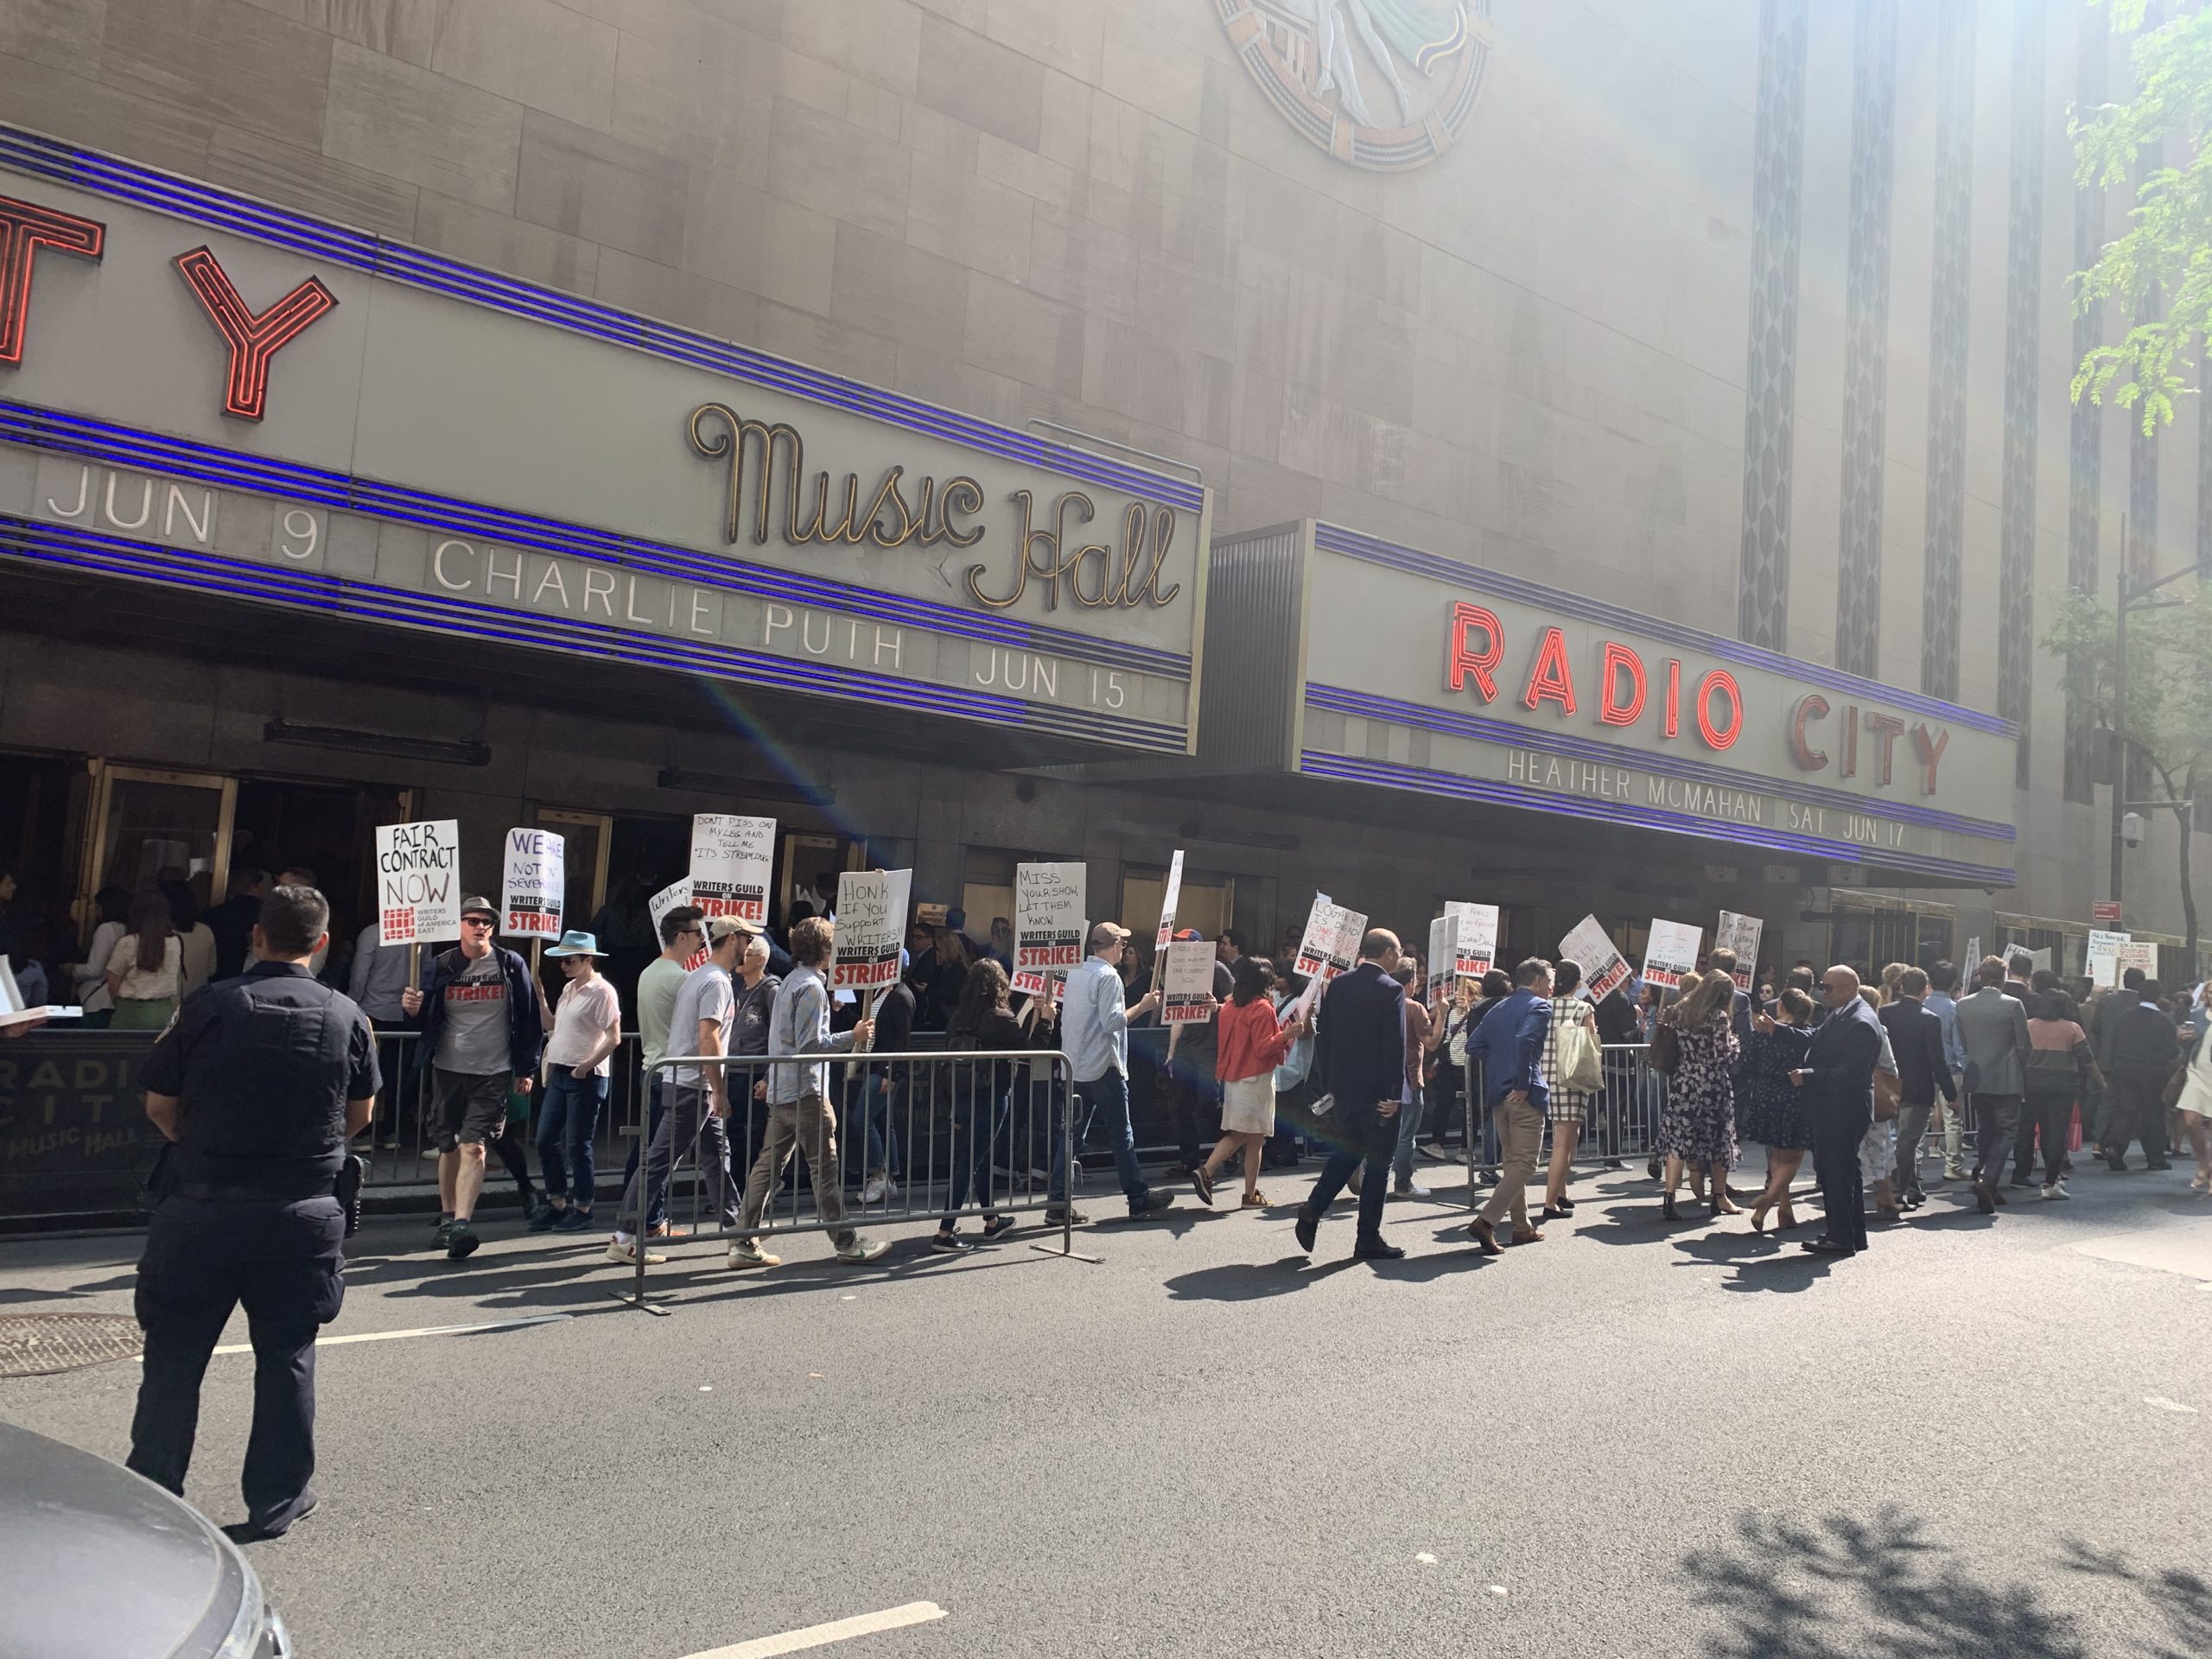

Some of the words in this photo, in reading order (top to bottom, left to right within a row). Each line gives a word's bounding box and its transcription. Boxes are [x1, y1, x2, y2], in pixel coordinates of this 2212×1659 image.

[685, 403, 985, 548] Music
[969, 489, 1180, 611] Hall
[46, 466, 212, 543] JUN
[280, 509, 319, 560] 9
[434, 540, 715, 635] CHARLIE
[765, 603, 902, 670] PUTH
[976, 647, 1058, 697] JUN
[1091, 670, 1124, 709] 15
[1444, 600, 1744, 751] RADIO
[1790, 693, 1950, 796] CITY
[1508, 748, 1630, 800] HEATHER
[1648, 775, 1762, 822] MCMAHAN
[1843, 815, 1877, 843] JUN
[1889, 822, 1904, 847] 17
[728, 817, 754, 829] PISS
[759, 821, 773, 830] ON
[393, 824, 439, 849] FAIR
[709, 827, 721, 837] MY
[722, 829, 741, 838] LEG
[744, 830, 765, 839] AND
[512, 830, 544, 855] WE
[718, 838, 739, 849] TELL
[741, 841, 754, 849] ME
[380, 846, 456, 874] CONTRACT
[513, 861, 541, 876] NOT
[1019, 870, 1062, 886] MISS
[386, 872, 450, 906] NOW
[693, 880, 733, 892] WRITERS
[735, 883, 764, 894] GUILD
[510, 894, 546, 906] WRITERS
[546, 898, 562, 909] GUILD
[651, 885, 690, 913] Writers
[1019, 902, 1040, 913] LET
[1042, 899, 1072, 912] THEM
[416, 907, 447, 916] WRITERS
[691, 897, 763, 921] STRIKE!
[1315, 900, 1350, 921] LOGAN
[1351, 912, 1366, 928] ROY
[425, 919, 457, 928] AMERICA
[508, 911, 561, 934] STRIKE!
[1314, 913, 1328, 925] IS
[1020, 930, 1056, 940] WRITERS
[1057, 929, 1080, 939] GUILD
[1457, 934, 1478, 944] SSIAN
[836, 945, 880, 957] WRITERS
[880, 941, 900, 955] GUILD
[1019, 945, 1081, 967] STRIKE!
[1303, 945, 1332, 960] WRITERS
[1332, 956, 1351, 967] GUILD
[1472, 949, 1491, 957] GUILD
[683, 946, 709, 973] IKE!
[1457, 959, 1491, 975] RIKE!
[1648, 958, 1673, 969] WRITERS
[1673, 963, 1691, 973] GUILD
[1736, 962, 1752, 970] GUILD
[834, 958, 899, 985] STRIKE!
[1584, 965, 1607, 986] WRITERS
[1605, 952, 1618, 967] GUILD
[1592, 960, 1629, 1000] STRIKE!
[446, 985, 505, 1001] STRIKE!
[1166, 993, 1192, 1001] WRITERS
[1192, 992, 1210, 1001] GUILD
[1165, 1006, 1208, 1021] STRIKE!
[0, 1059, 129, 1090] RADI
